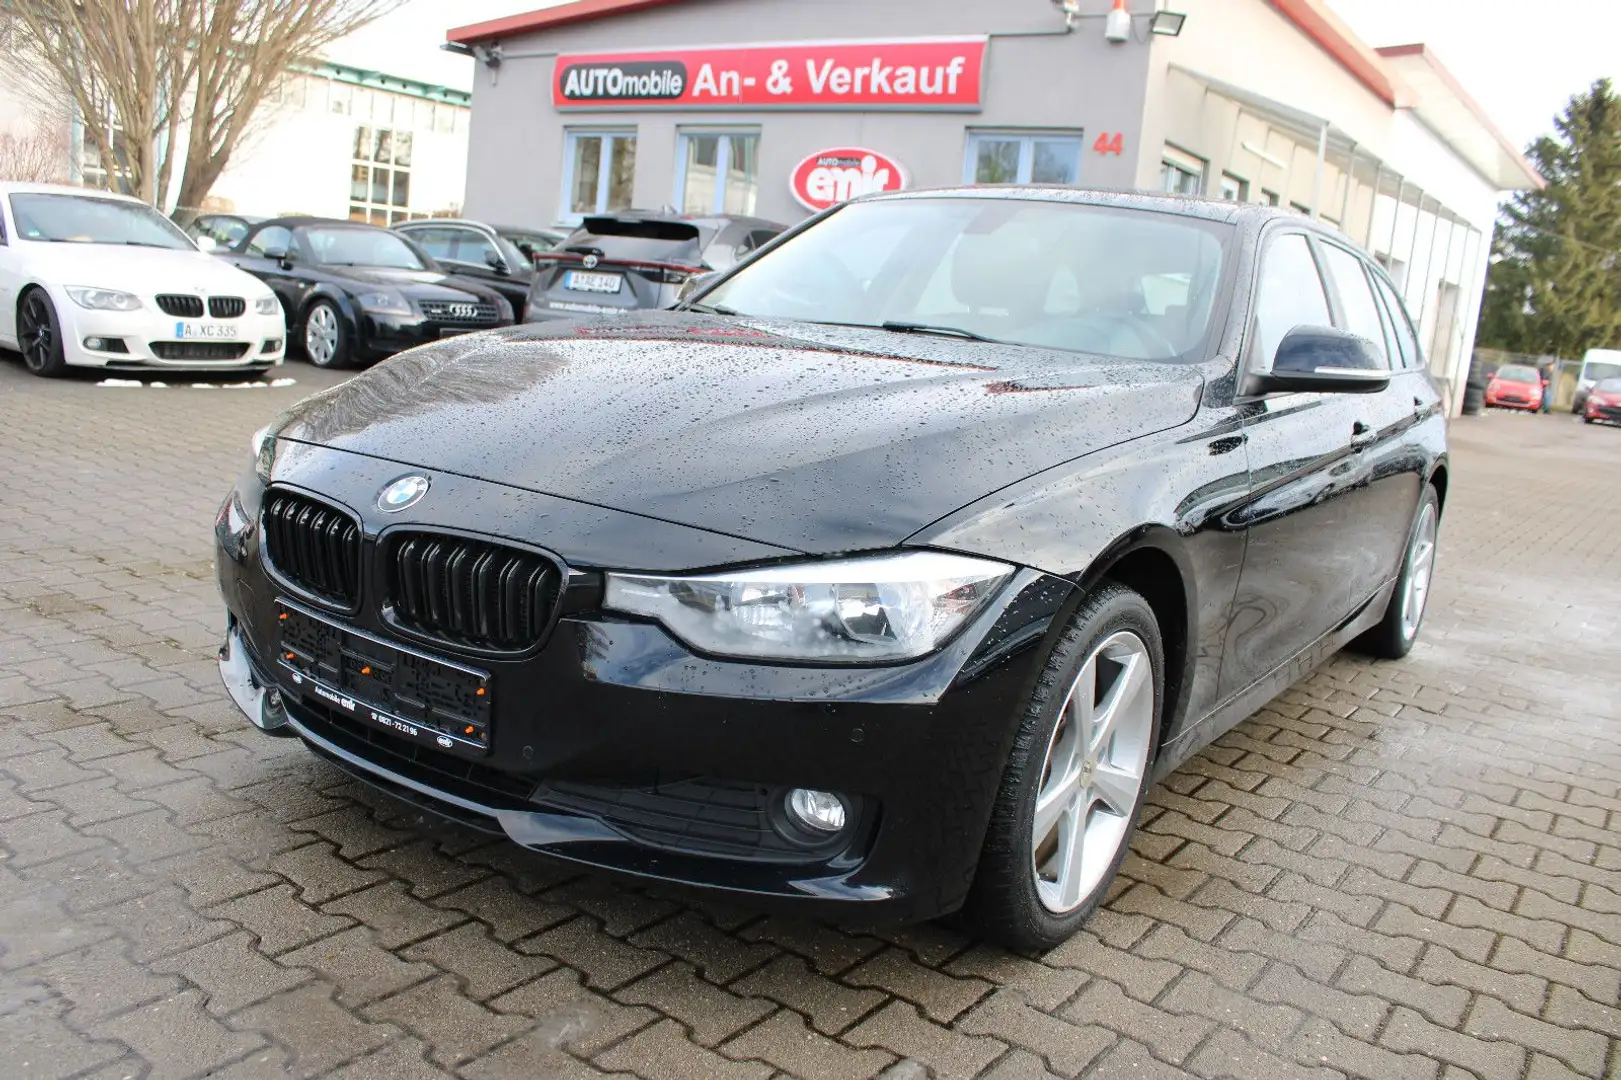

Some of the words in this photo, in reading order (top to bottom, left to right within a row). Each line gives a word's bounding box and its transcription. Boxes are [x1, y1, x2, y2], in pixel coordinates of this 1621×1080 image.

[564, 68, 683, 96] AUTOmobile
[692, 63, 756, 97] An-
[765, 59, 794, 95] &
[806, 56, 965, 95] Verkauf
[1092, 131, 1123, 156] 44
[806, 154, 889, 201] emir
[185, 324, 192, 336] A
[200, 324, 214, 337] XC
[216, 325, 237, 338] 335
